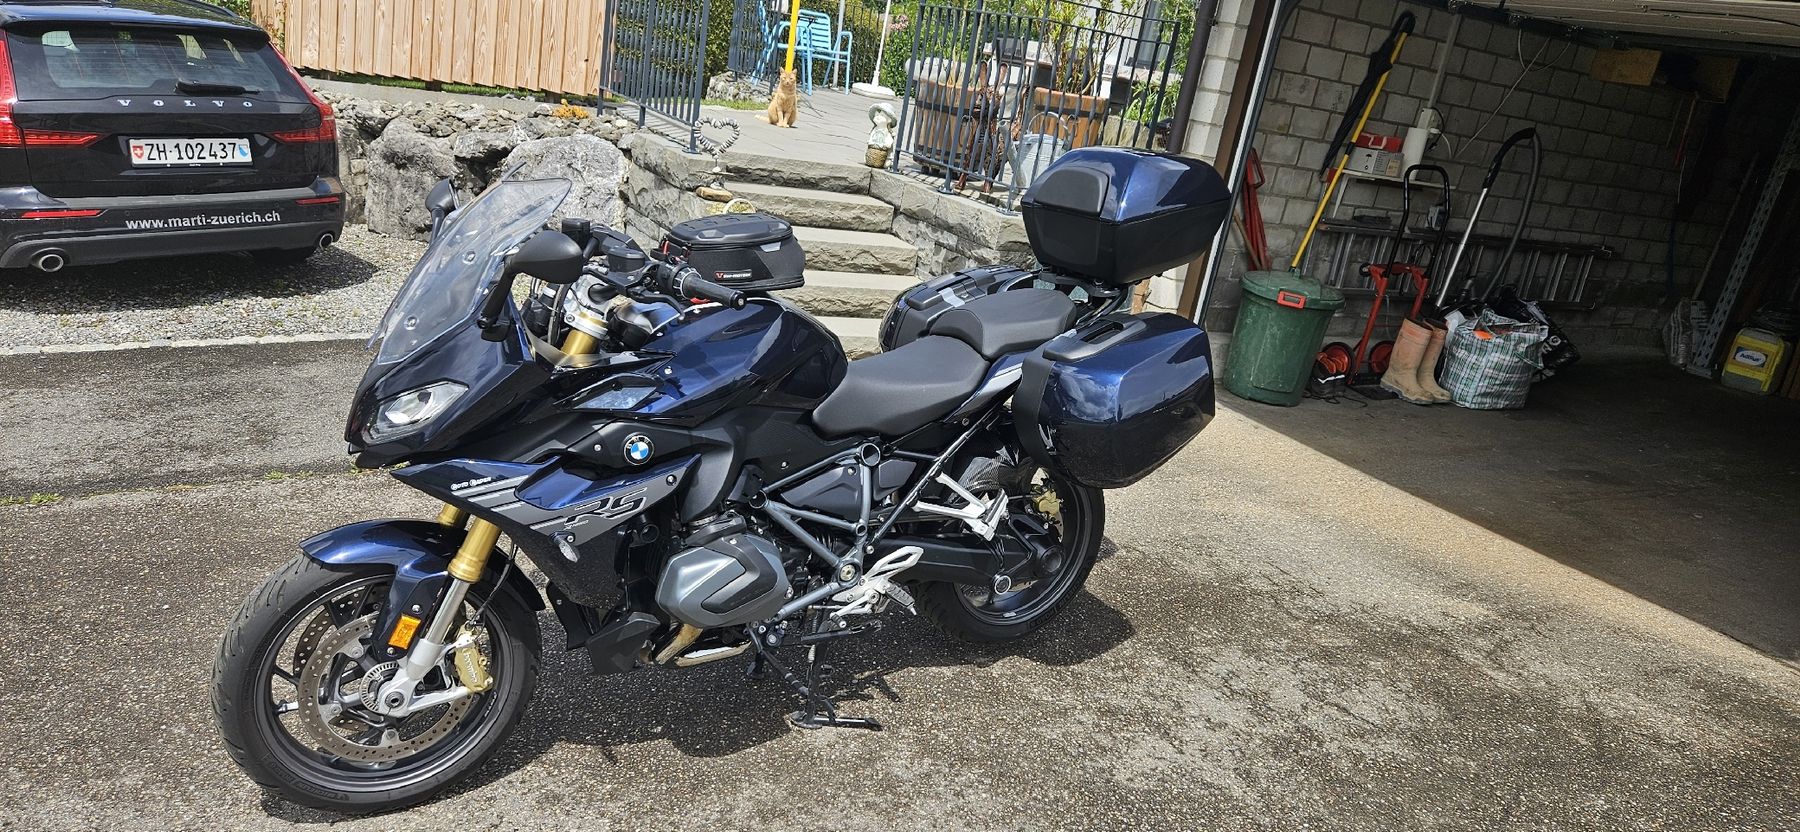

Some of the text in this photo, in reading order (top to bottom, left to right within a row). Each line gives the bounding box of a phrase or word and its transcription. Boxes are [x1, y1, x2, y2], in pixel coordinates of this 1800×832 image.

[117, 99, 253, 107] VOLVO
[125, 210, 281, 230] www.marti-zuerich.ch
[564, 487, 648, 525] RS
